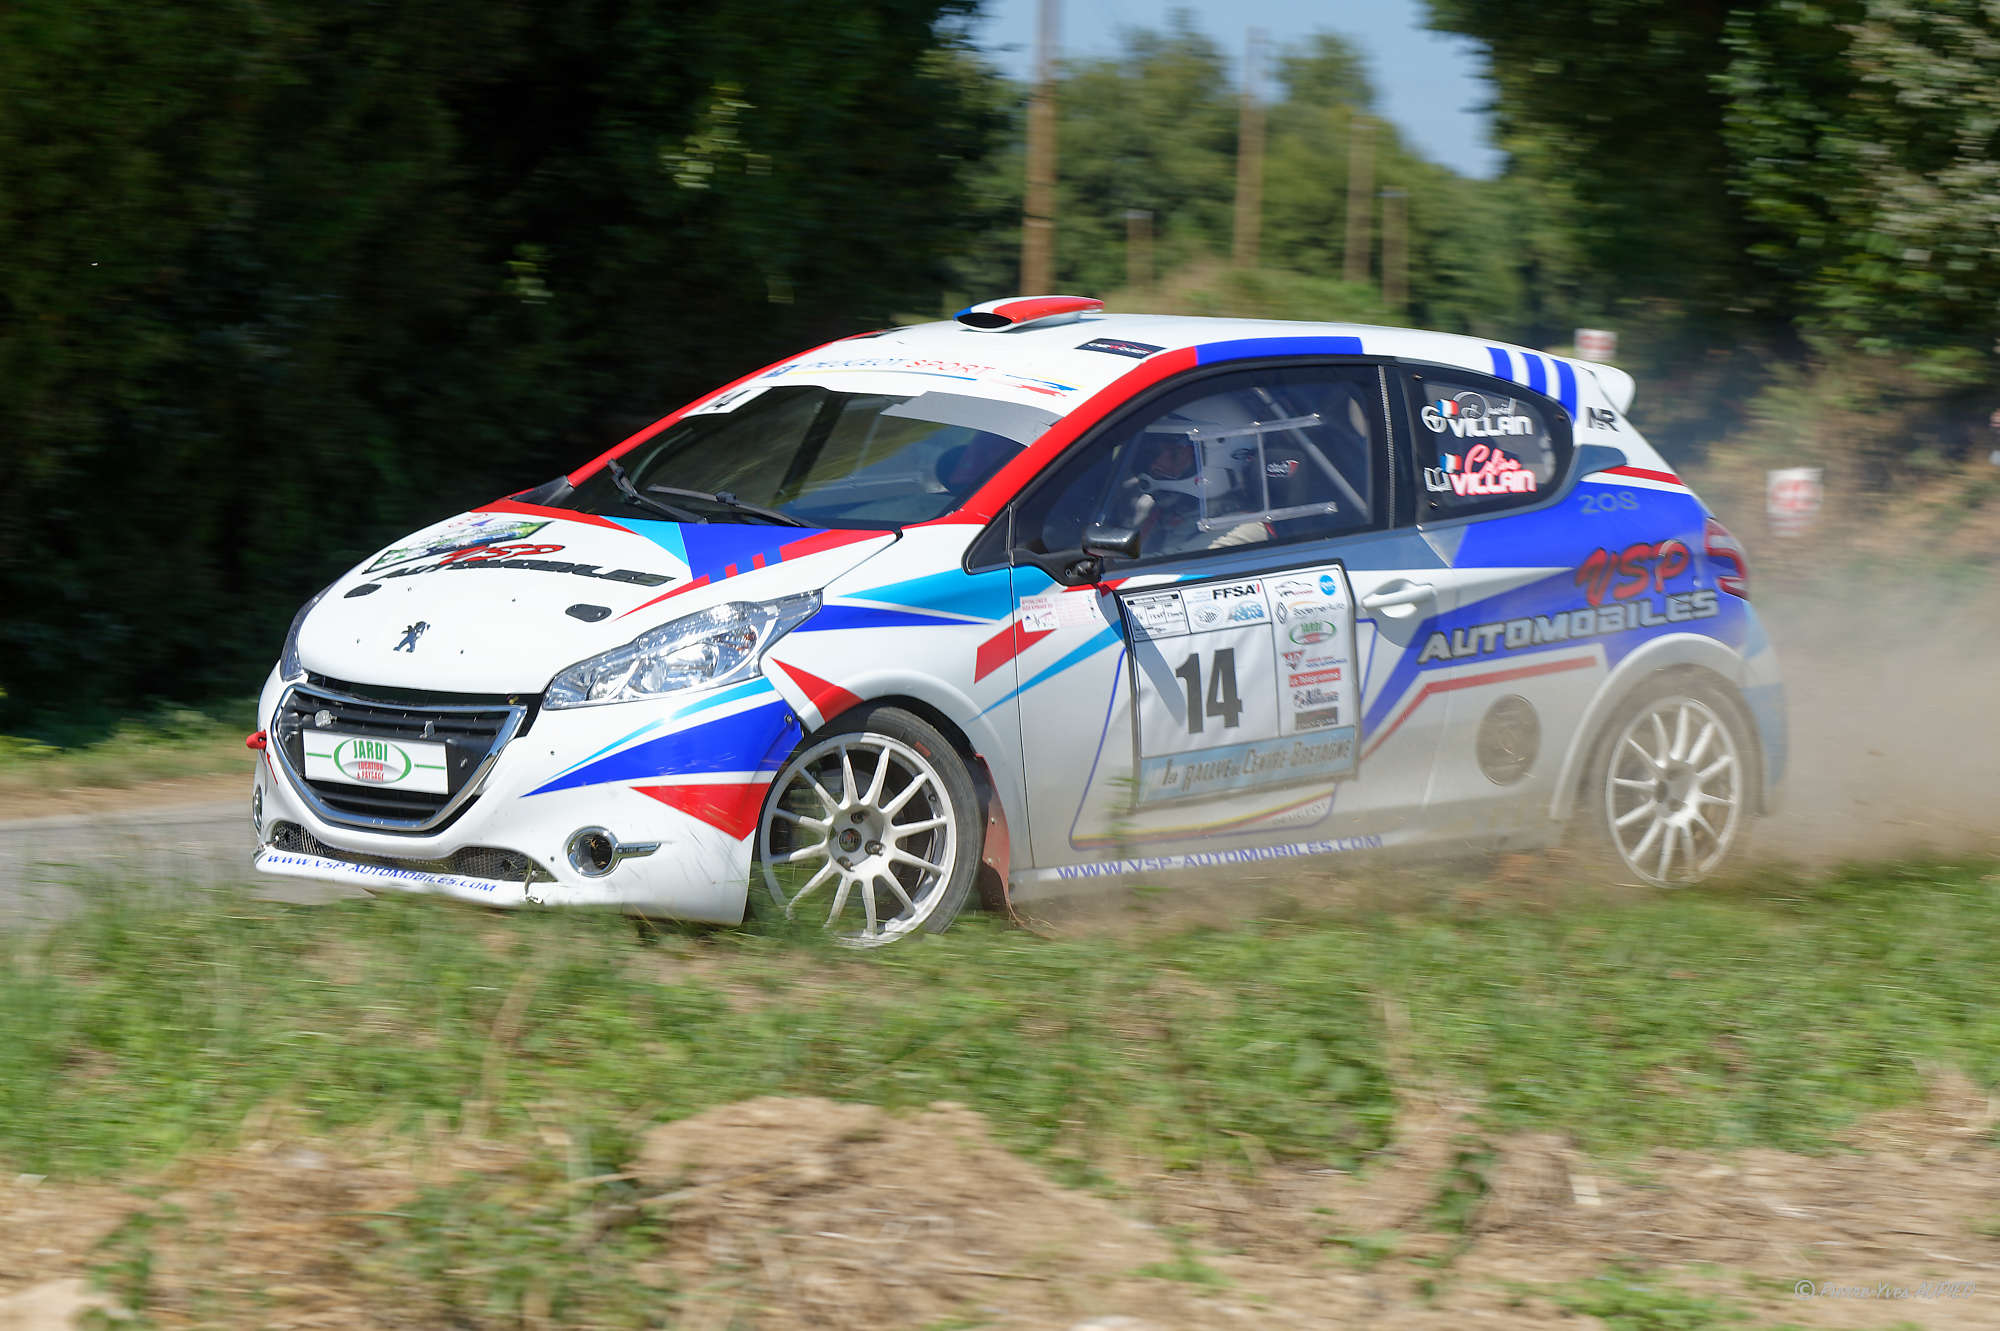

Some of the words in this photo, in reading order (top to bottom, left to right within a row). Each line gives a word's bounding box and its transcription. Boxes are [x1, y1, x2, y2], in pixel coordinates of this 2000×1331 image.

[1449, 469, 1537, 496] VILLAIN
[1212, 584, 1256, 600] FFSA
[1575, 540, 1691, 607] VSP
[1417, 589, 1719, 665] AUTOMOBILES
[1175, 647, 1243, 734] 14
[353, 740, 388, 762] JARDI
